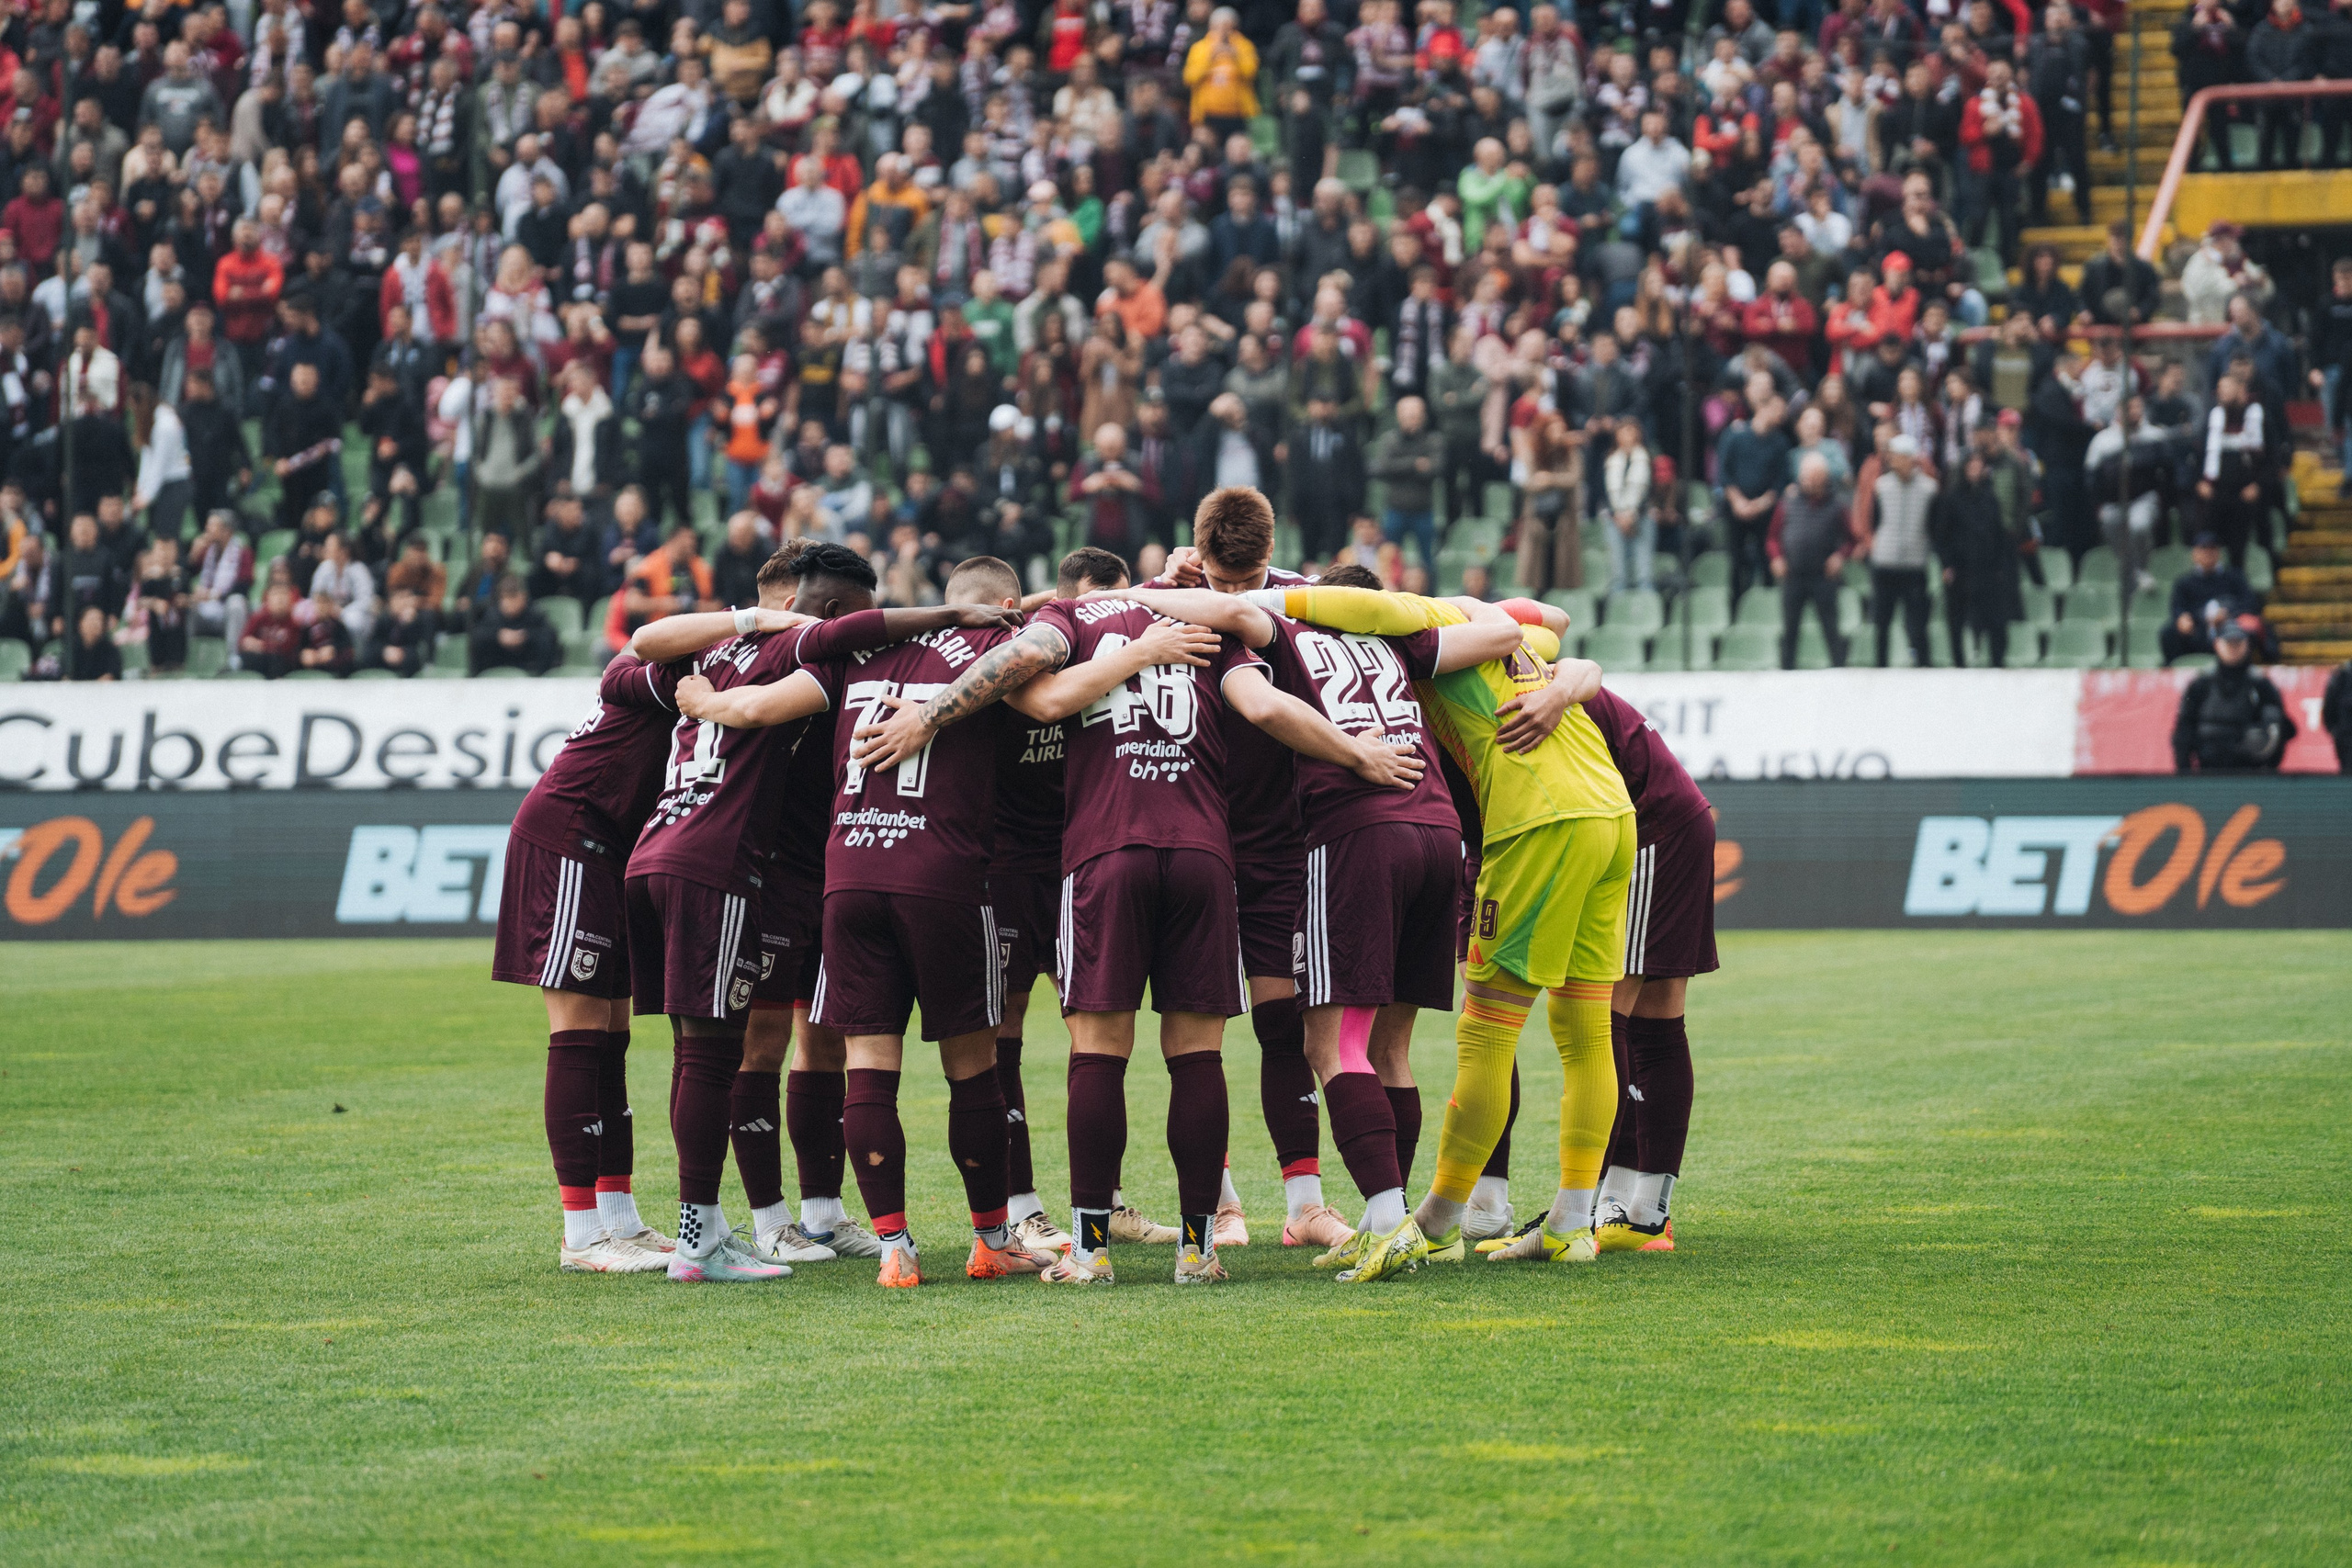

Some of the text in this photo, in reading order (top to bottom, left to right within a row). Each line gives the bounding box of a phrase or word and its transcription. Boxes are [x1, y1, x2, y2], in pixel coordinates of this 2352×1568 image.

[1295, 631, 1422, 728] 22
[663, 715, 727, 792] 1
[843, 679, 952, 798] 77
[1114, 739, 1188, 760] meridian
[1129, 758, 1159, 781] bh
[843, 827, 876, 848] bh
[0, 815, 180, 926] Ole
[1470, 897, 1499, 941] 9
